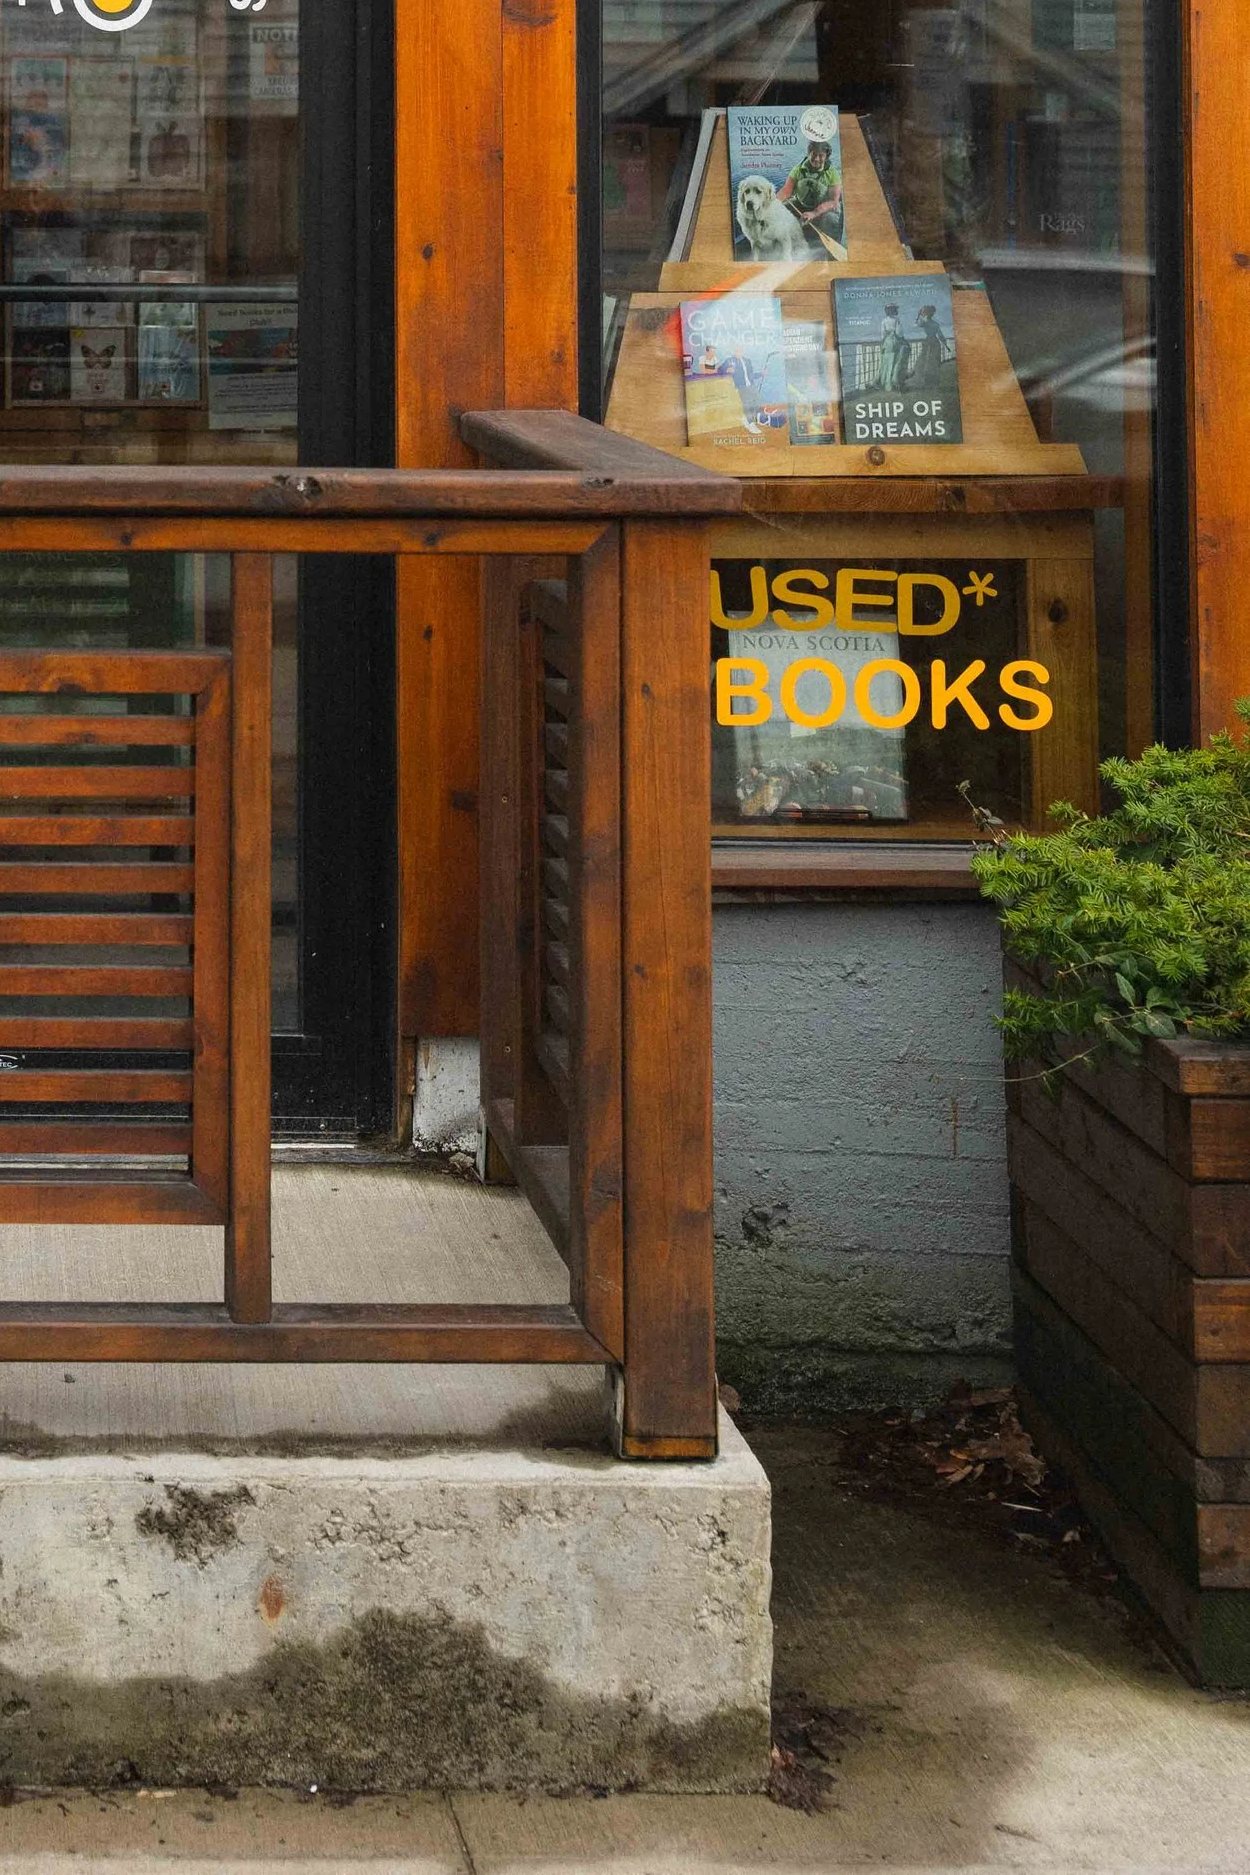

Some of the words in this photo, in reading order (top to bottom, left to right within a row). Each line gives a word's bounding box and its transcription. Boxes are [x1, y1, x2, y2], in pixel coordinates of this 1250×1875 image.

[737, 115, 781, 126] WAKING
[783, 115, 797, 126] UP
[740, 126, 750, 135] IN
[754, 126, 771, 135] MY
[772, 126, 798, 134] OWN
[740, 135, 798, 146] BACKYARD
[844, 291, 873, 299] DONNA
[876, 290, 902, 298] JONES
[687, 307, 775, 331] GAME
[855, 401, 904, 419] SHIP
[913, 400, 942, 416] OF
[855, 420, 946, 439] DREAMS
[743, 634, 798, 651] NOVA
[807, 635, 886, 652] SCOTIA
[716, 657, 1053, 731] BOOKS
